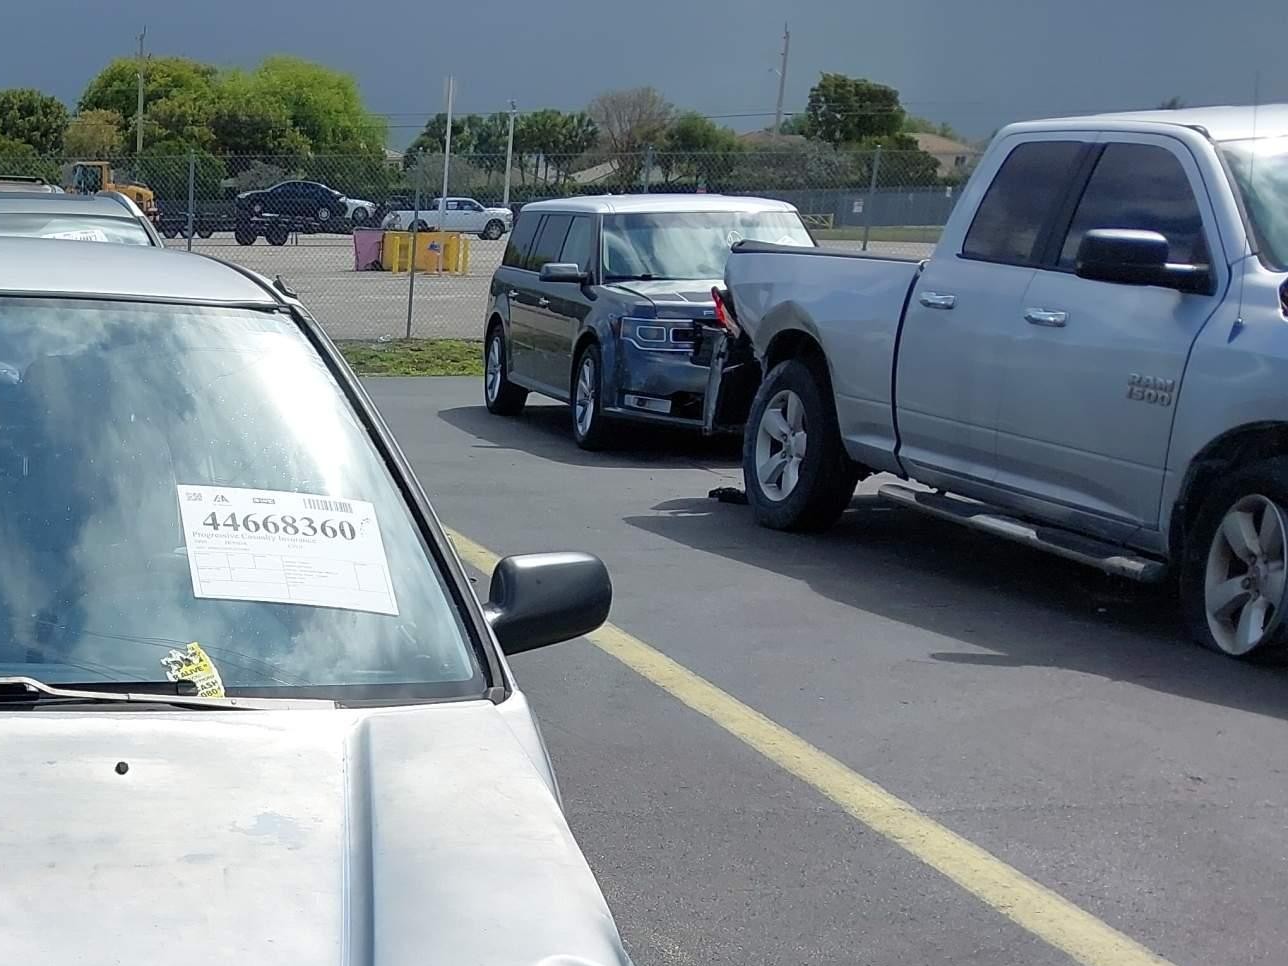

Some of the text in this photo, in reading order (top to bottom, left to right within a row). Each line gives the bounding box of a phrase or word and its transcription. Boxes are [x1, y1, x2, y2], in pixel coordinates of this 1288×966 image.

[1127, 372, 1176, 393] RAM
[1126, 386, 1173, 408] 1500
[191, 531, 240, 540] Progressive
[202, 511, 357, 541] 44668360
